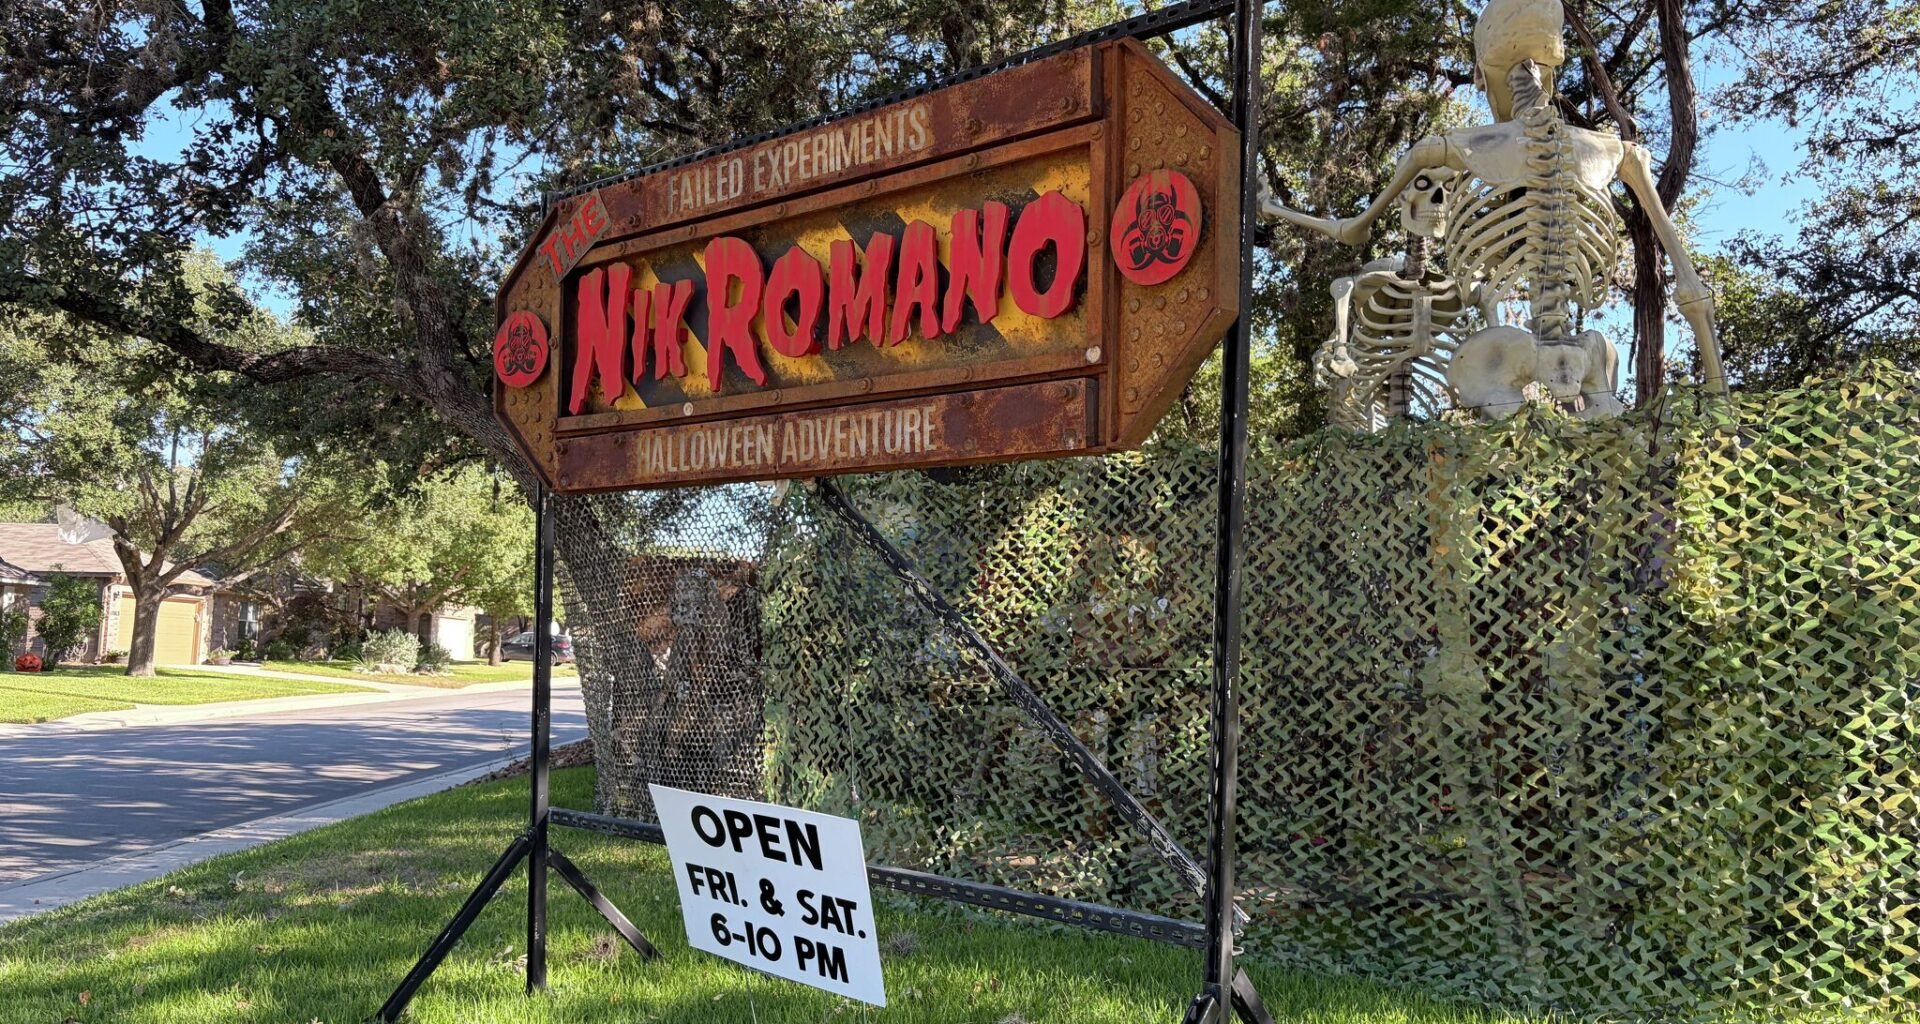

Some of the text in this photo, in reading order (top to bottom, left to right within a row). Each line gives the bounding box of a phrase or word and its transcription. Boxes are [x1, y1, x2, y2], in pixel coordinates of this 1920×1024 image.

[667, 102, 927, 215] FAILED EXPERIMENTS
[539, 195, 606, 275] THE
[637, 404, 938, 479] HALLOWEEN ADVENTURE
[690, 804, 824, 871] OPEN
[685, 861, 867, 939] FRI. & SAT.
[710, 912, 849, 984] 6-10 PM
